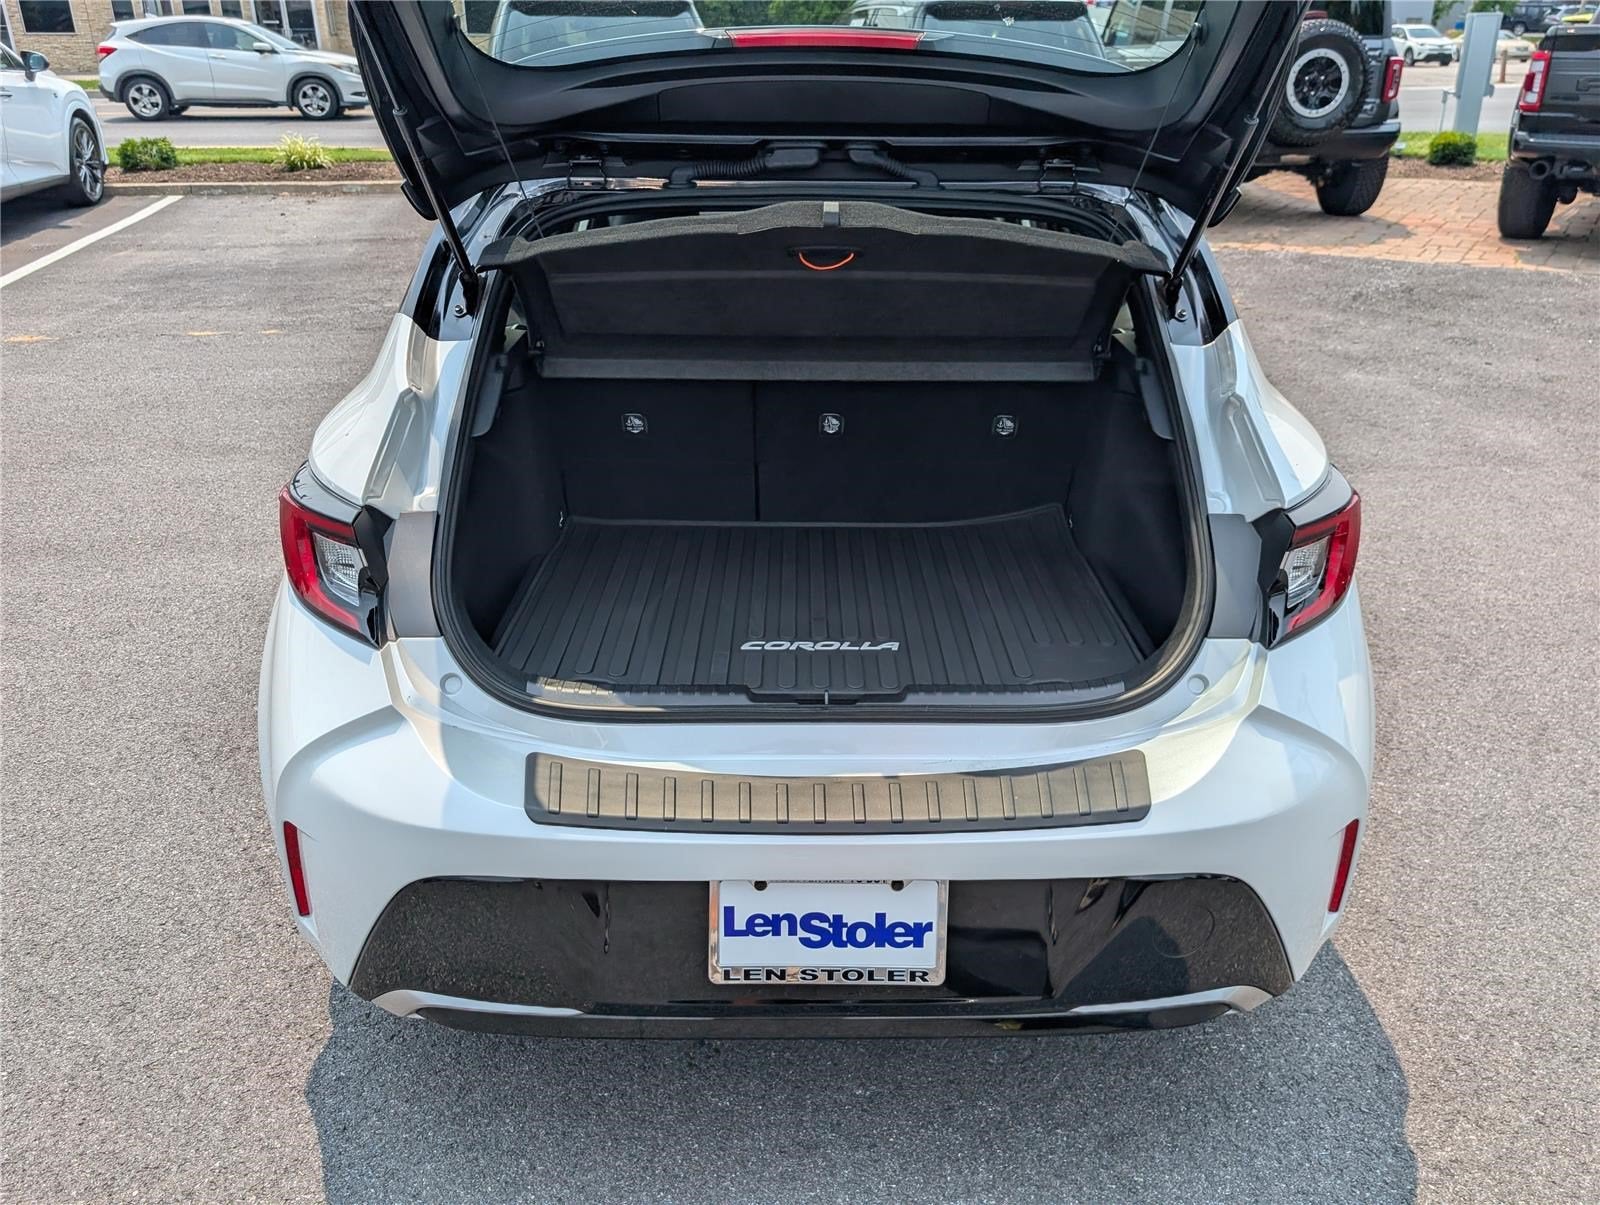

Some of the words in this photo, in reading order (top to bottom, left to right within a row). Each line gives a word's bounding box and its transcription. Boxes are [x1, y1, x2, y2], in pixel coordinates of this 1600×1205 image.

[740, 641, 900, 651] COROLLA
[723, 969, 786, 981] LEN
[799, 968, 929, 982] STOLER
